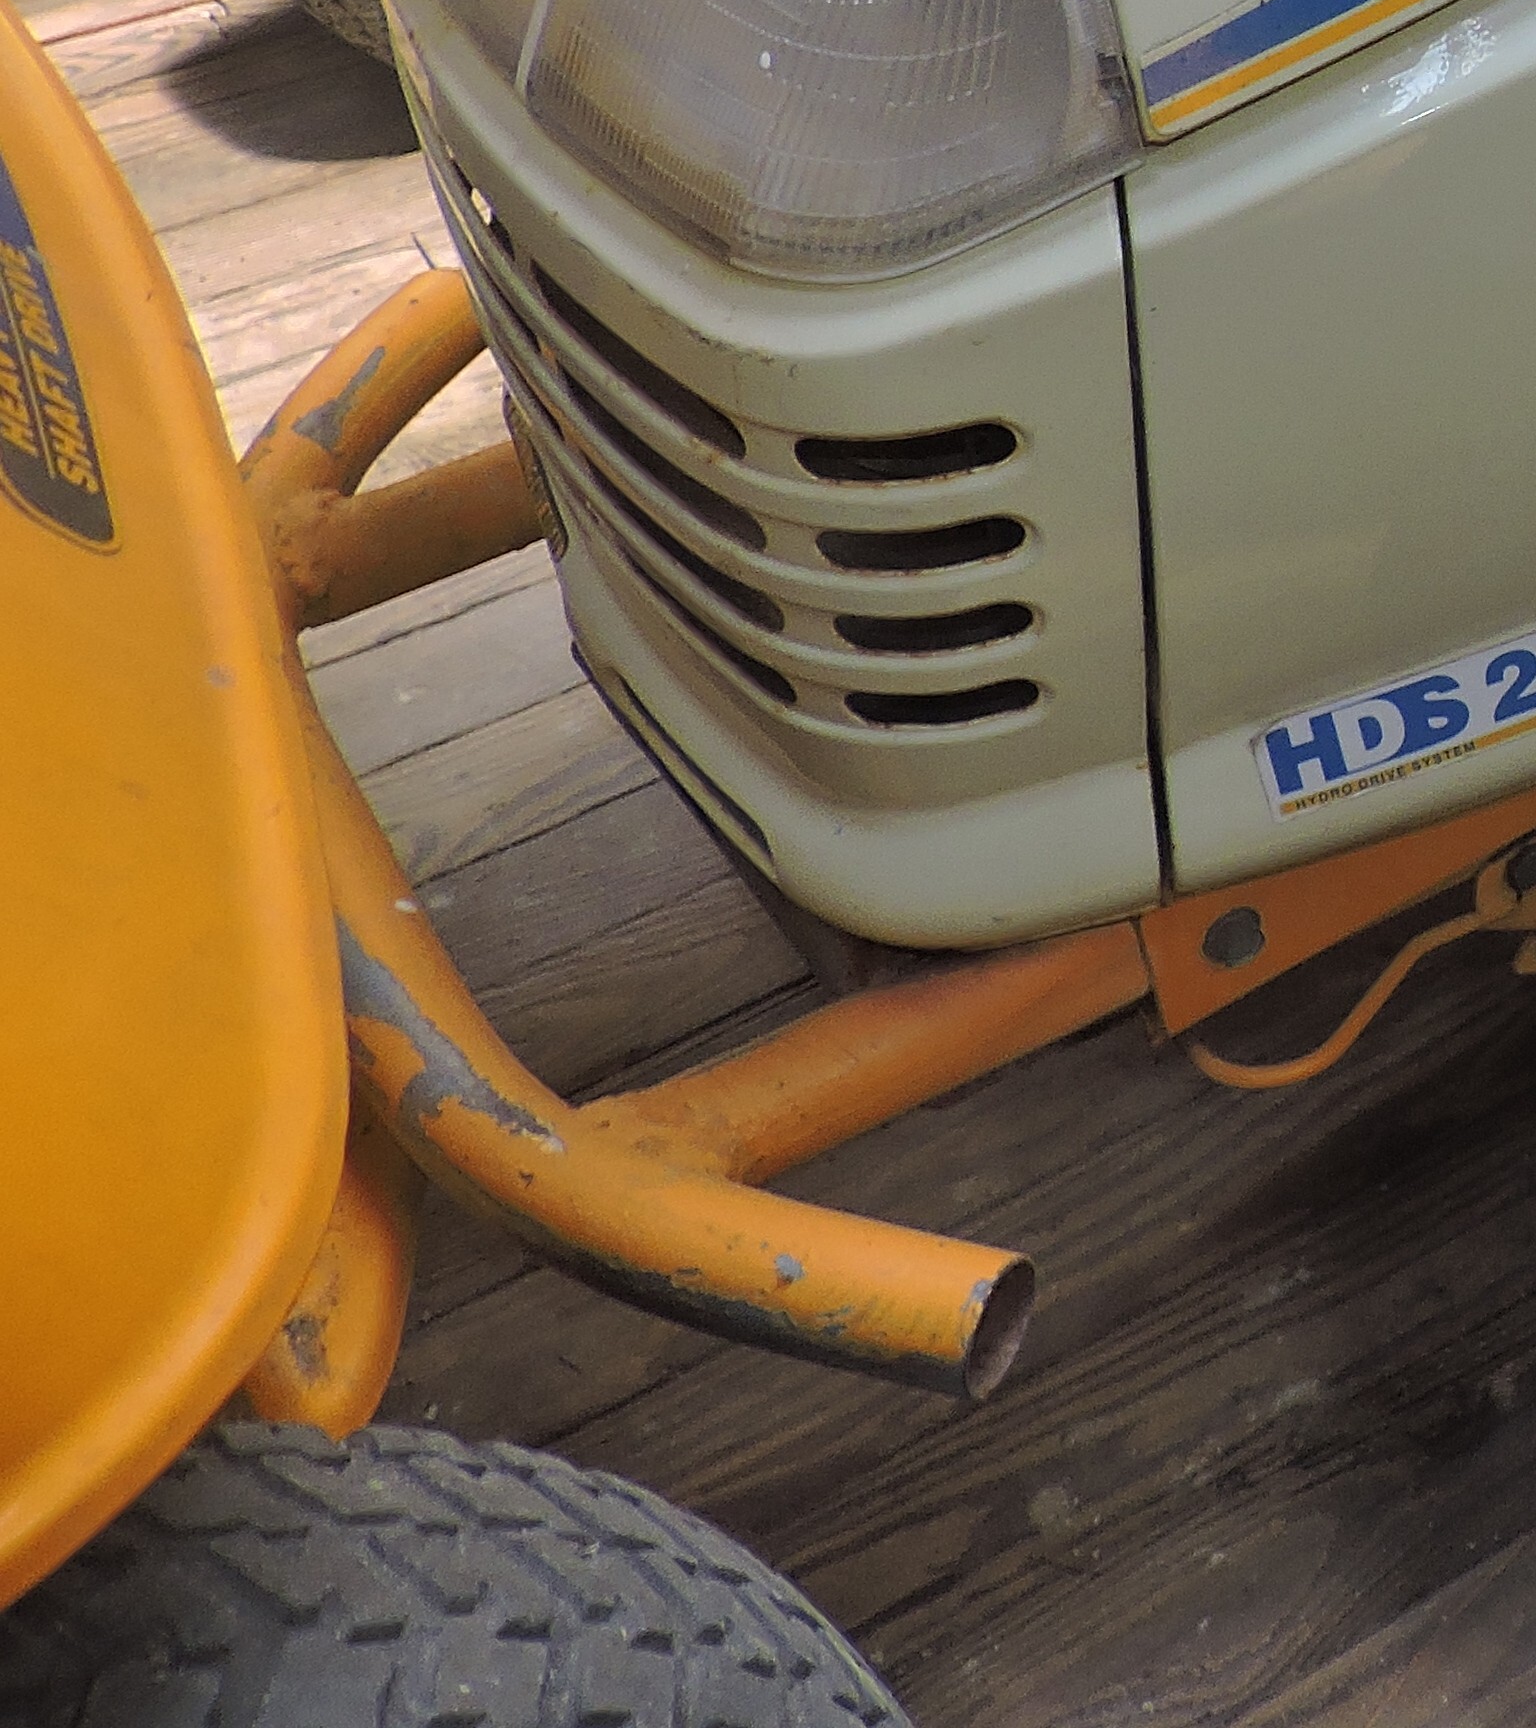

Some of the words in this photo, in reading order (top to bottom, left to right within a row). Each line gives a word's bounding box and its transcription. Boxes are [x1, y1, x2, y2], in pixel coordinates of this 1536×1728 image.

[28, 349, 100, 495] SHAFT
[1265, 674, 1470, 795] HDS
[1295, 783, 1352, 811] HYDRO
[1358, 766, 1407, 791] DRIVE
[1412, 741, 1476, 772] SYSTEM
